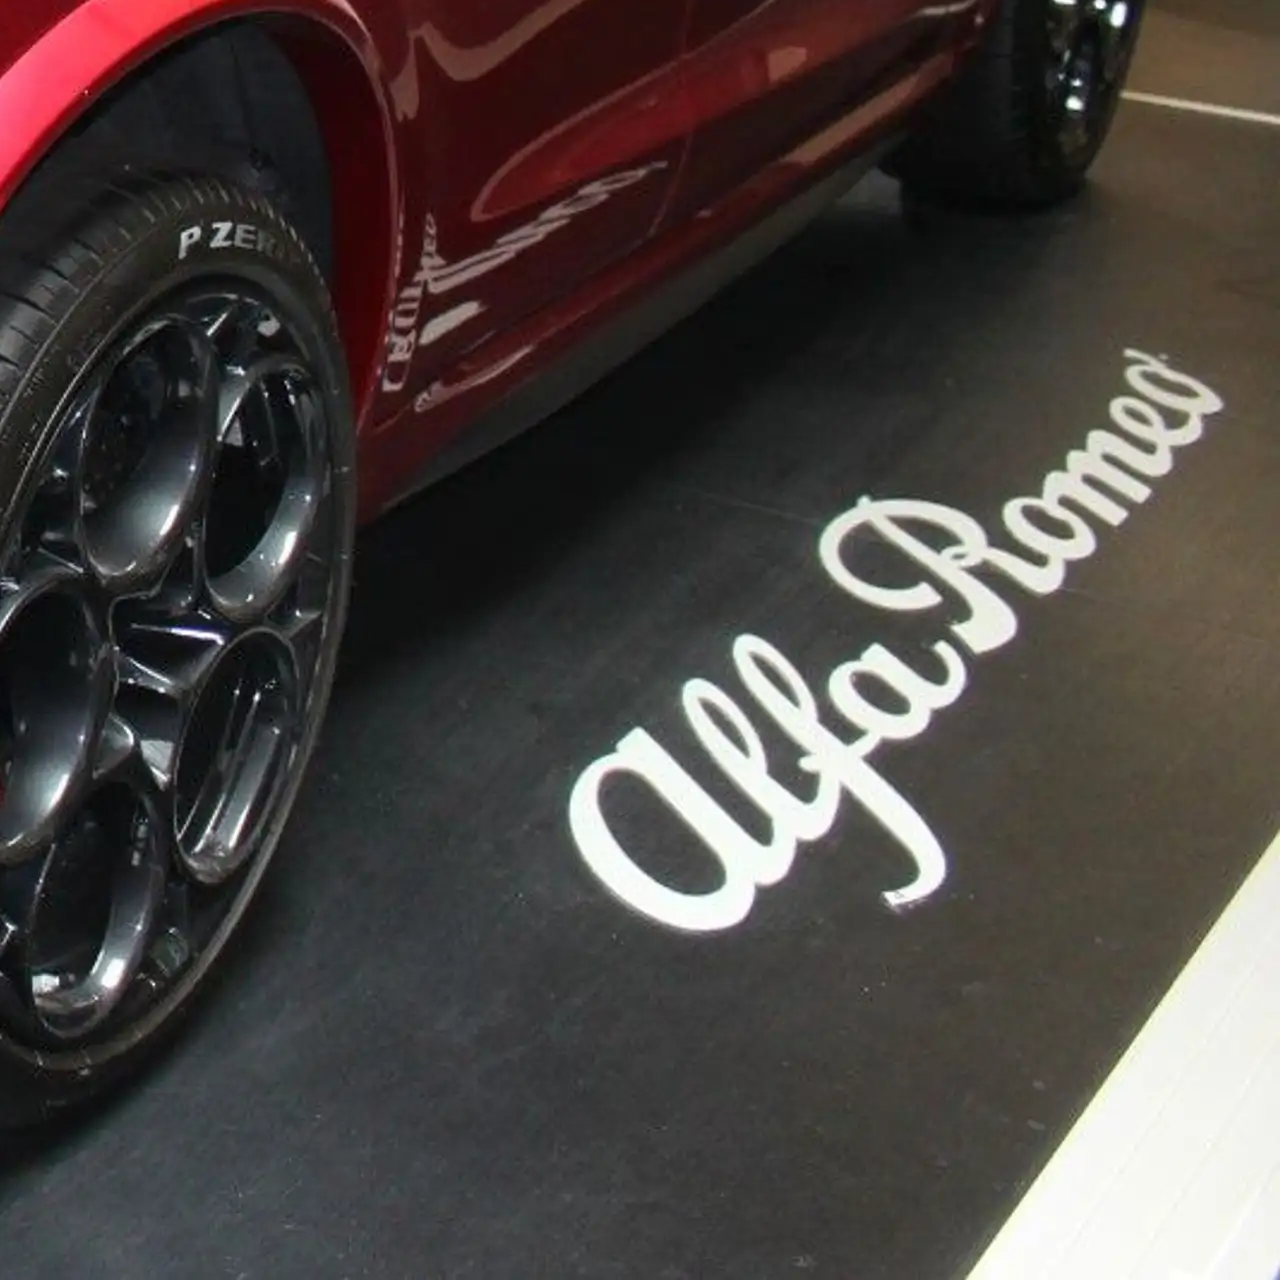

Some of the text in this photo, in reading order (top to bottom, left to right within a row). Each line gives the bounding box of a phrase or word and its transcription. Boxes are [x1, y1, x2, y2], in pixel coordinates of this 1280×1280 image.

[209, 221, 283, 260] ZER
[568, 347, 1225, 932] Alfa Romeo
